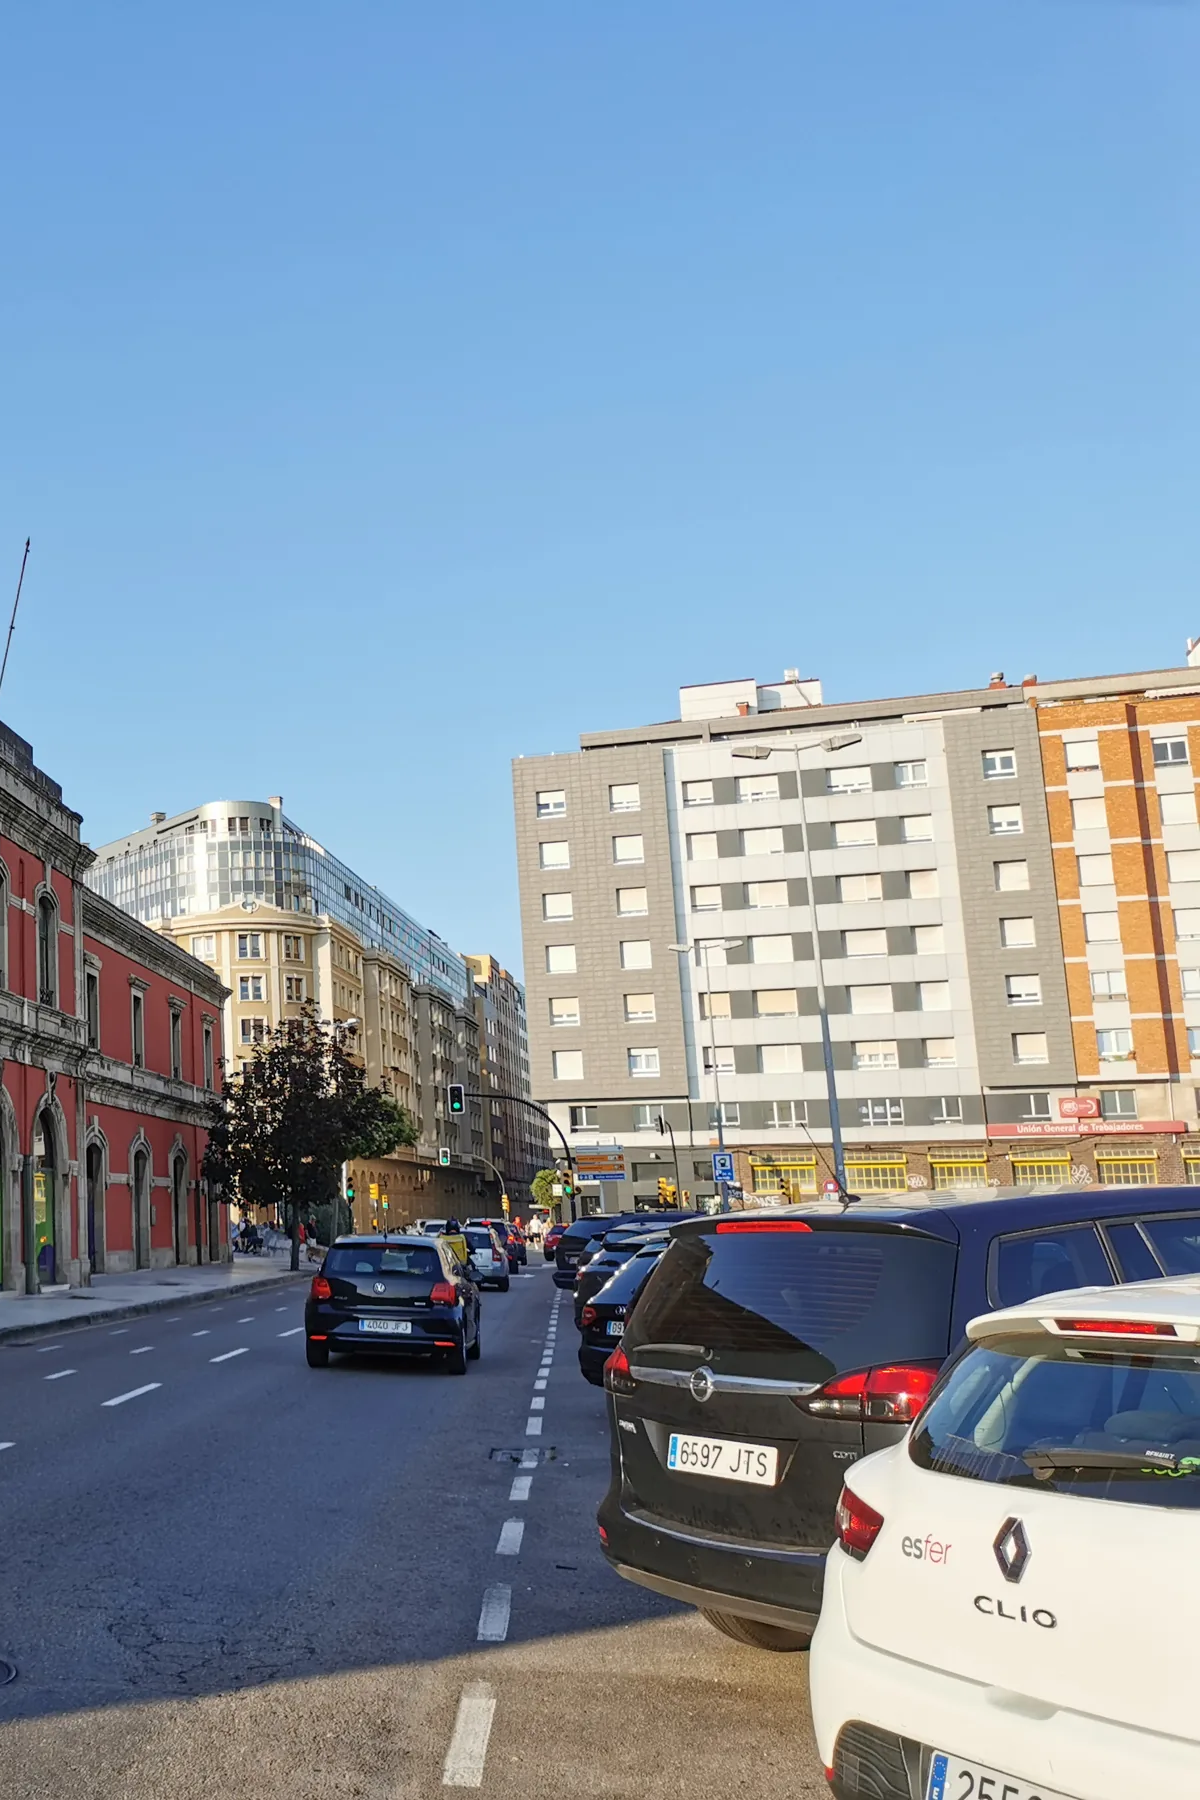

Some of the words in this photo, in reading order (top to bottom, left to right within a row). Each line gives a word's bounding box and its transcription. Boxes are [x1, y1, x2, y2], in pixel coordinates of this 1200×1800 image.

[1016, 1124, 1042, 1133] Unión
[1043, 1124, 1076, 1133] General
[1078, 1123, 1089, 1132] de
[1091, 1122, 1144, 1132] Trabajadores
[366, 1320, 389, 1330] 4040
[612, 1322, 625, 1334] 09
[680, 1441, 723, 1469] 6597
[729, 1448, 768, 1477] JTS
[832, 1450, 858, 1461] CDTI
[901, 1533, 952, 1565] esfer
[973, 1595, 1058, 1629] CLIO
